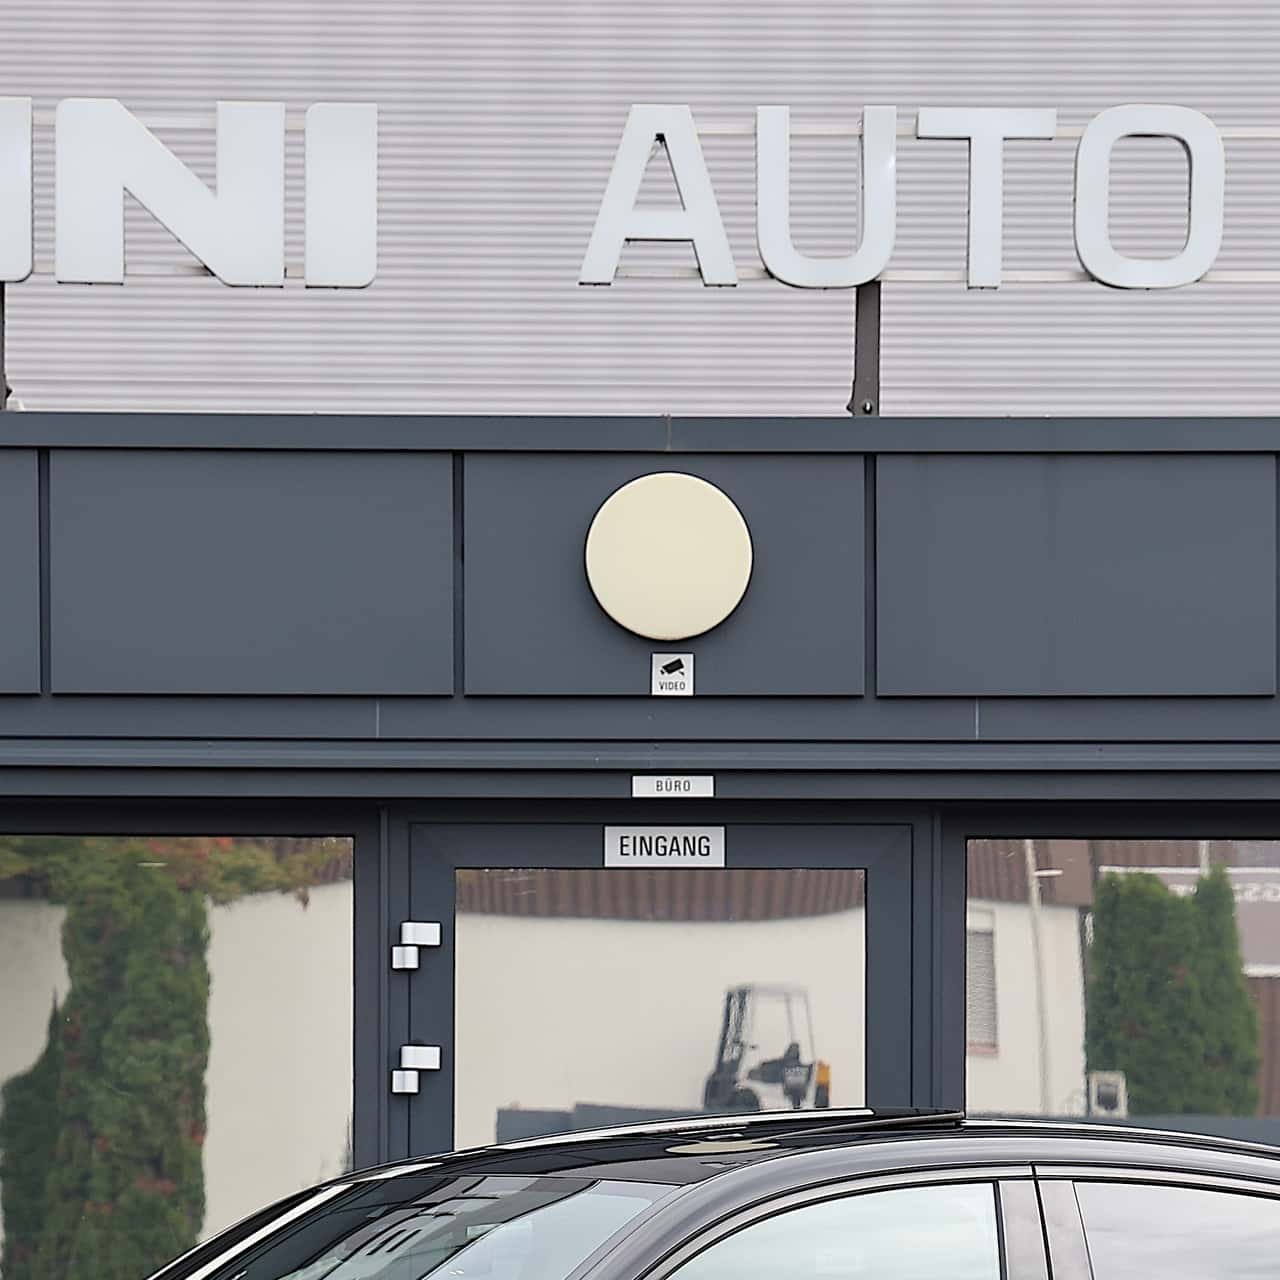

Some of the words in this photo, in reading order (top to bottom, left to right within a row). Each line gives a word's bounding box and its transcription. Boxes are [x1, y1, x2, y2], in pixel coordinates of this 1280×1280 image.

[579, 103, 1226, 291] AUTO
[658, 681, 686, 691] VIDEO
[655, 777, 691, 792] BÜRO
[619, 835, 711, 857] EINGANG
